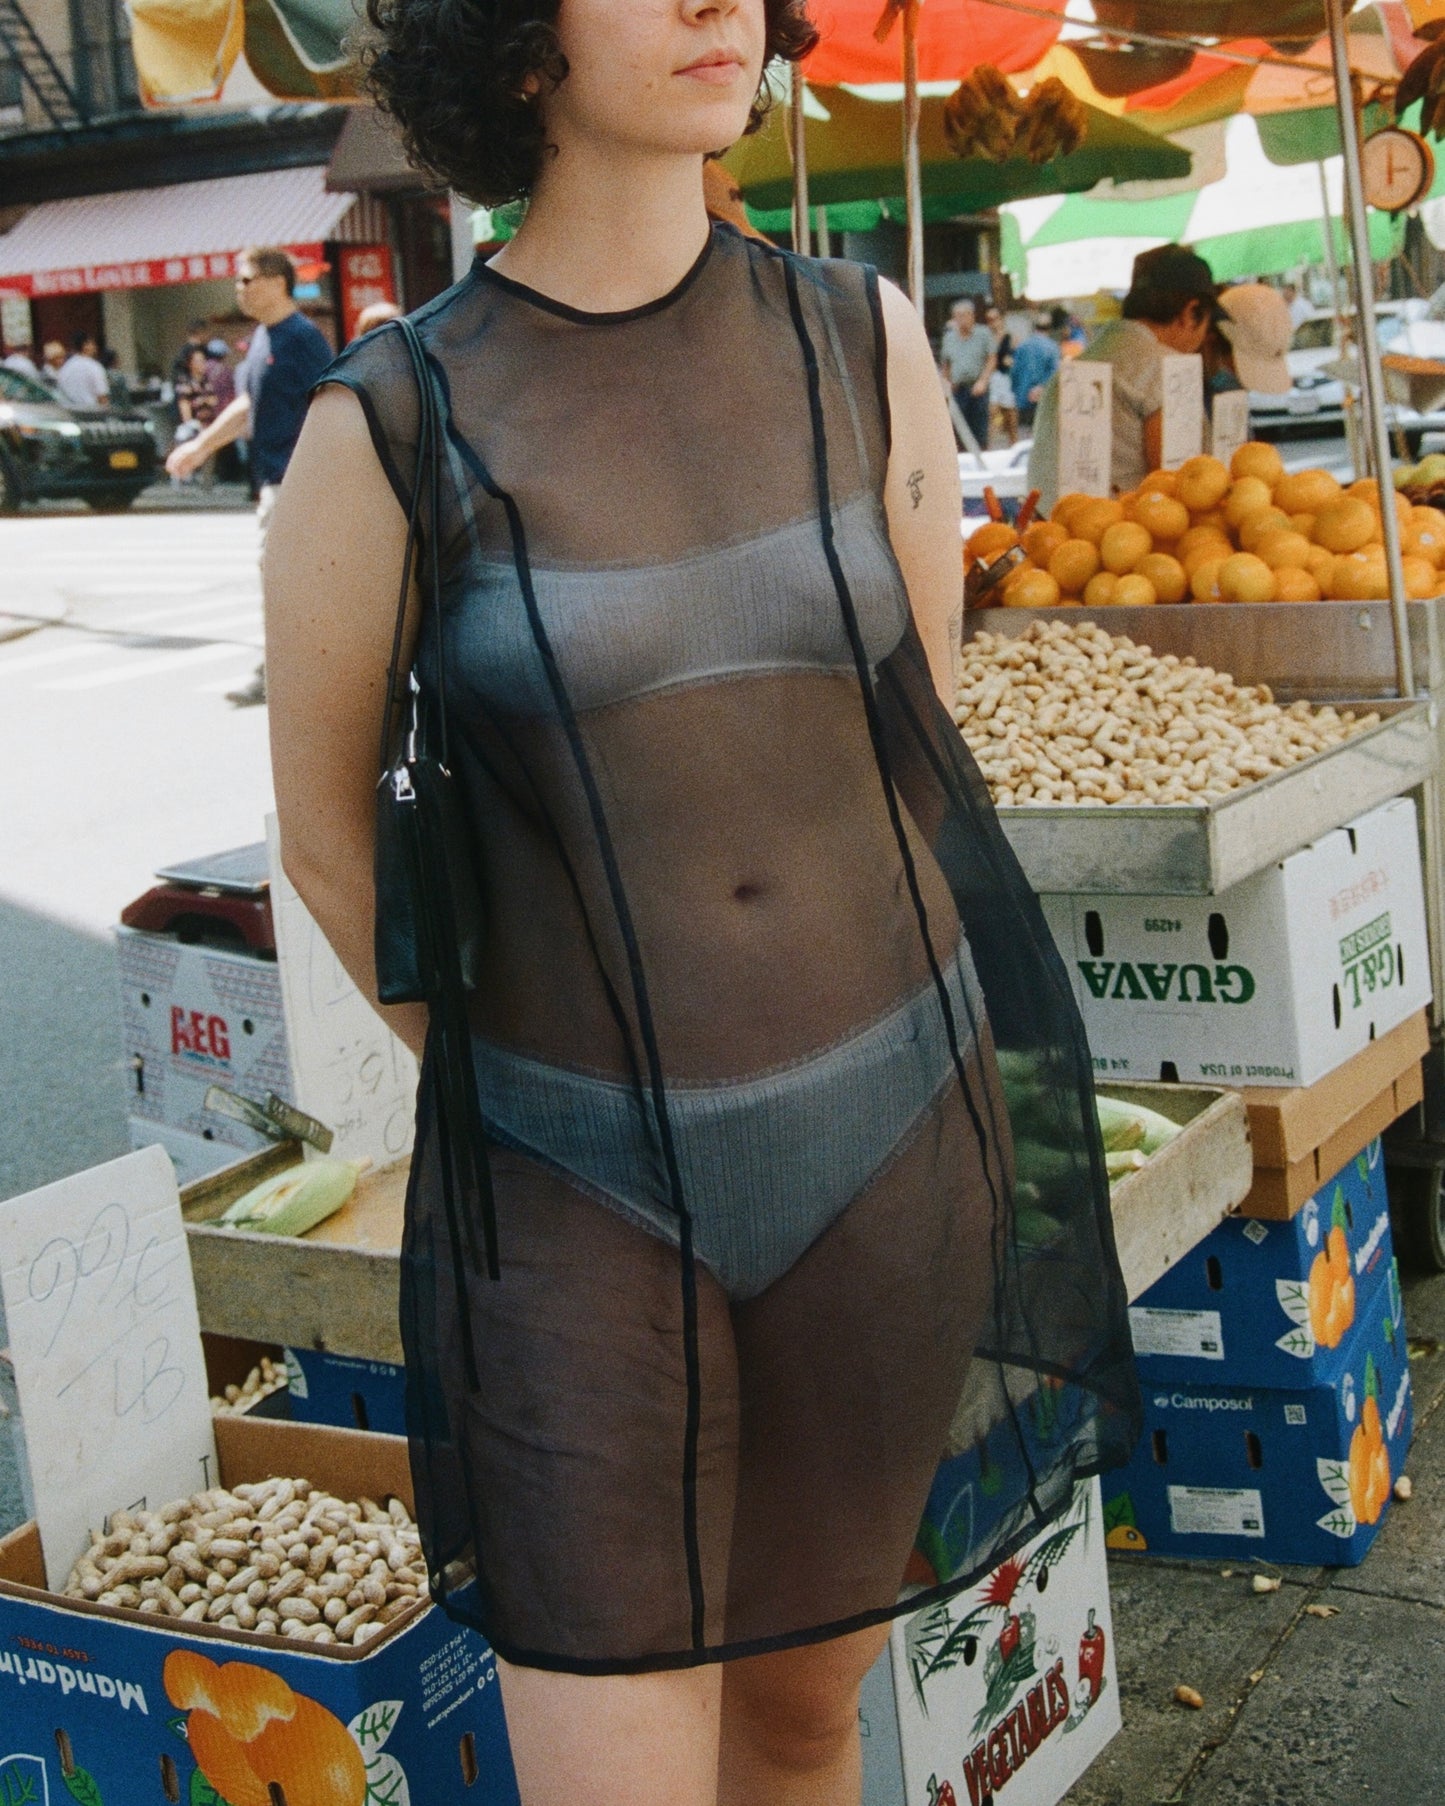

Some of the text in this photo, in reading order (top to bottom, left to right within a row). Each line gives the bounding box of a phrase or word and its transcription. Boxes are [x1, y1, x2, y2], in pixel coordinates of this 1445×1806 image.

[1077, 960, 1256, 1004] GUAVA
[1343, 943, 1395, 1009] G&L
[1200, 1063, 1295, 1079] Product of USA
[1171, 1393, 1253, 1412] Camposol
[962, 1657, 1070, 1806] VEGETABLES
